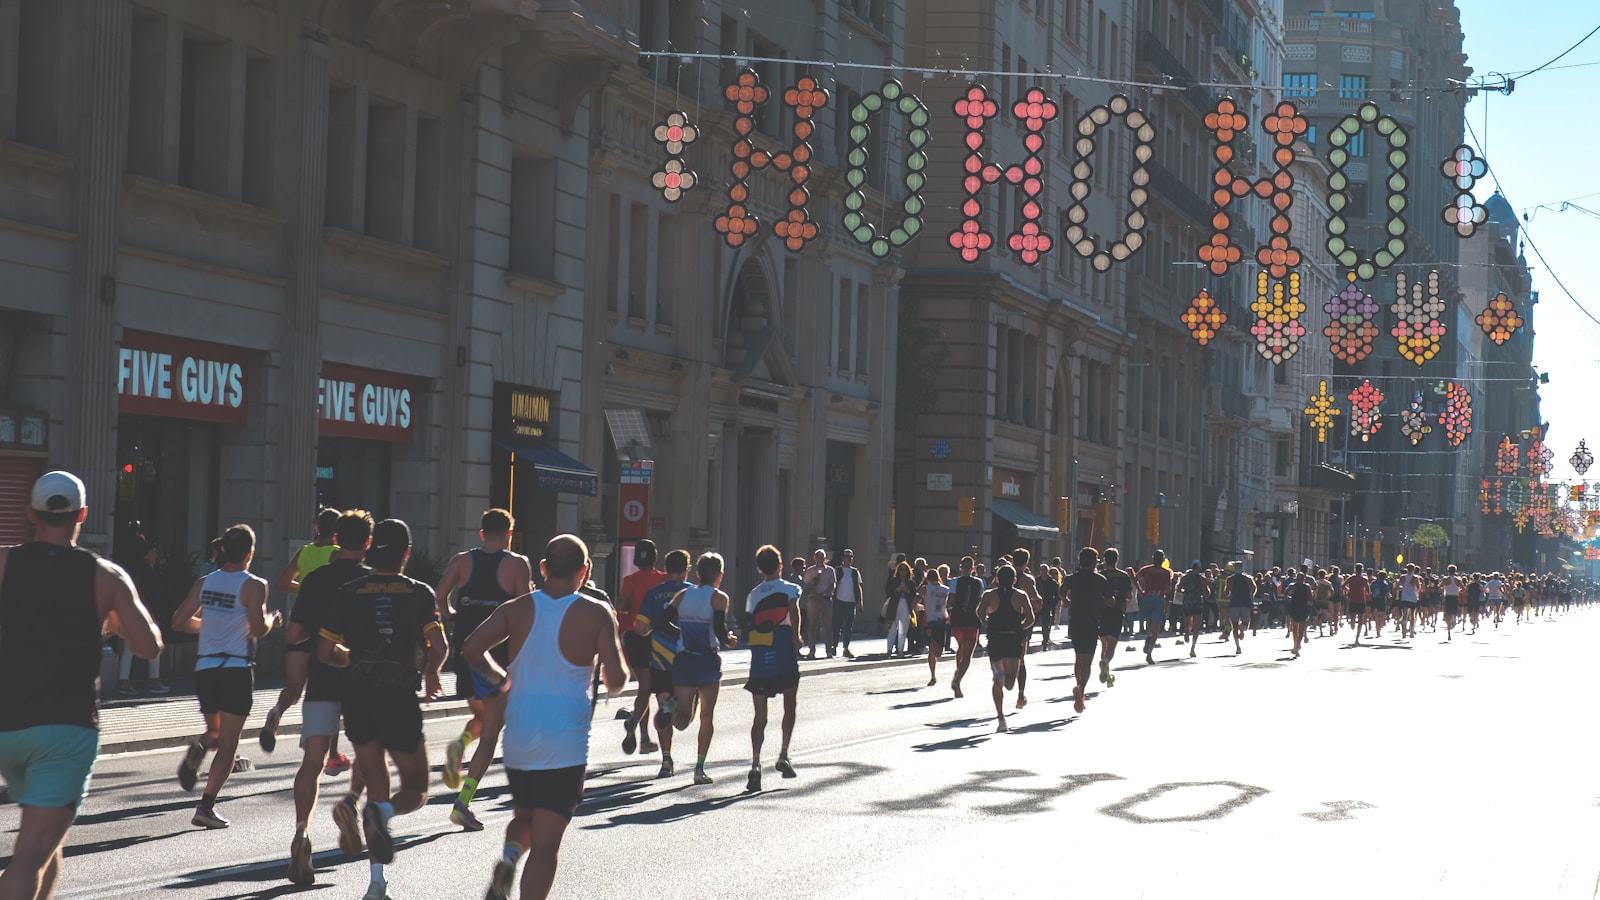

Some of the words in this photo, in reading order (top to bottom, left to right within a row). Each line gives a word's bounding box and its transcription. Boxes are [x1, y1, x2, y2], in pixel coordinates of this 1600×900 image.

[118, 348, 172, 399] FIVE
[181, 356, 243, 408] GUYS
[362, 383, 411, 428] GUYS
